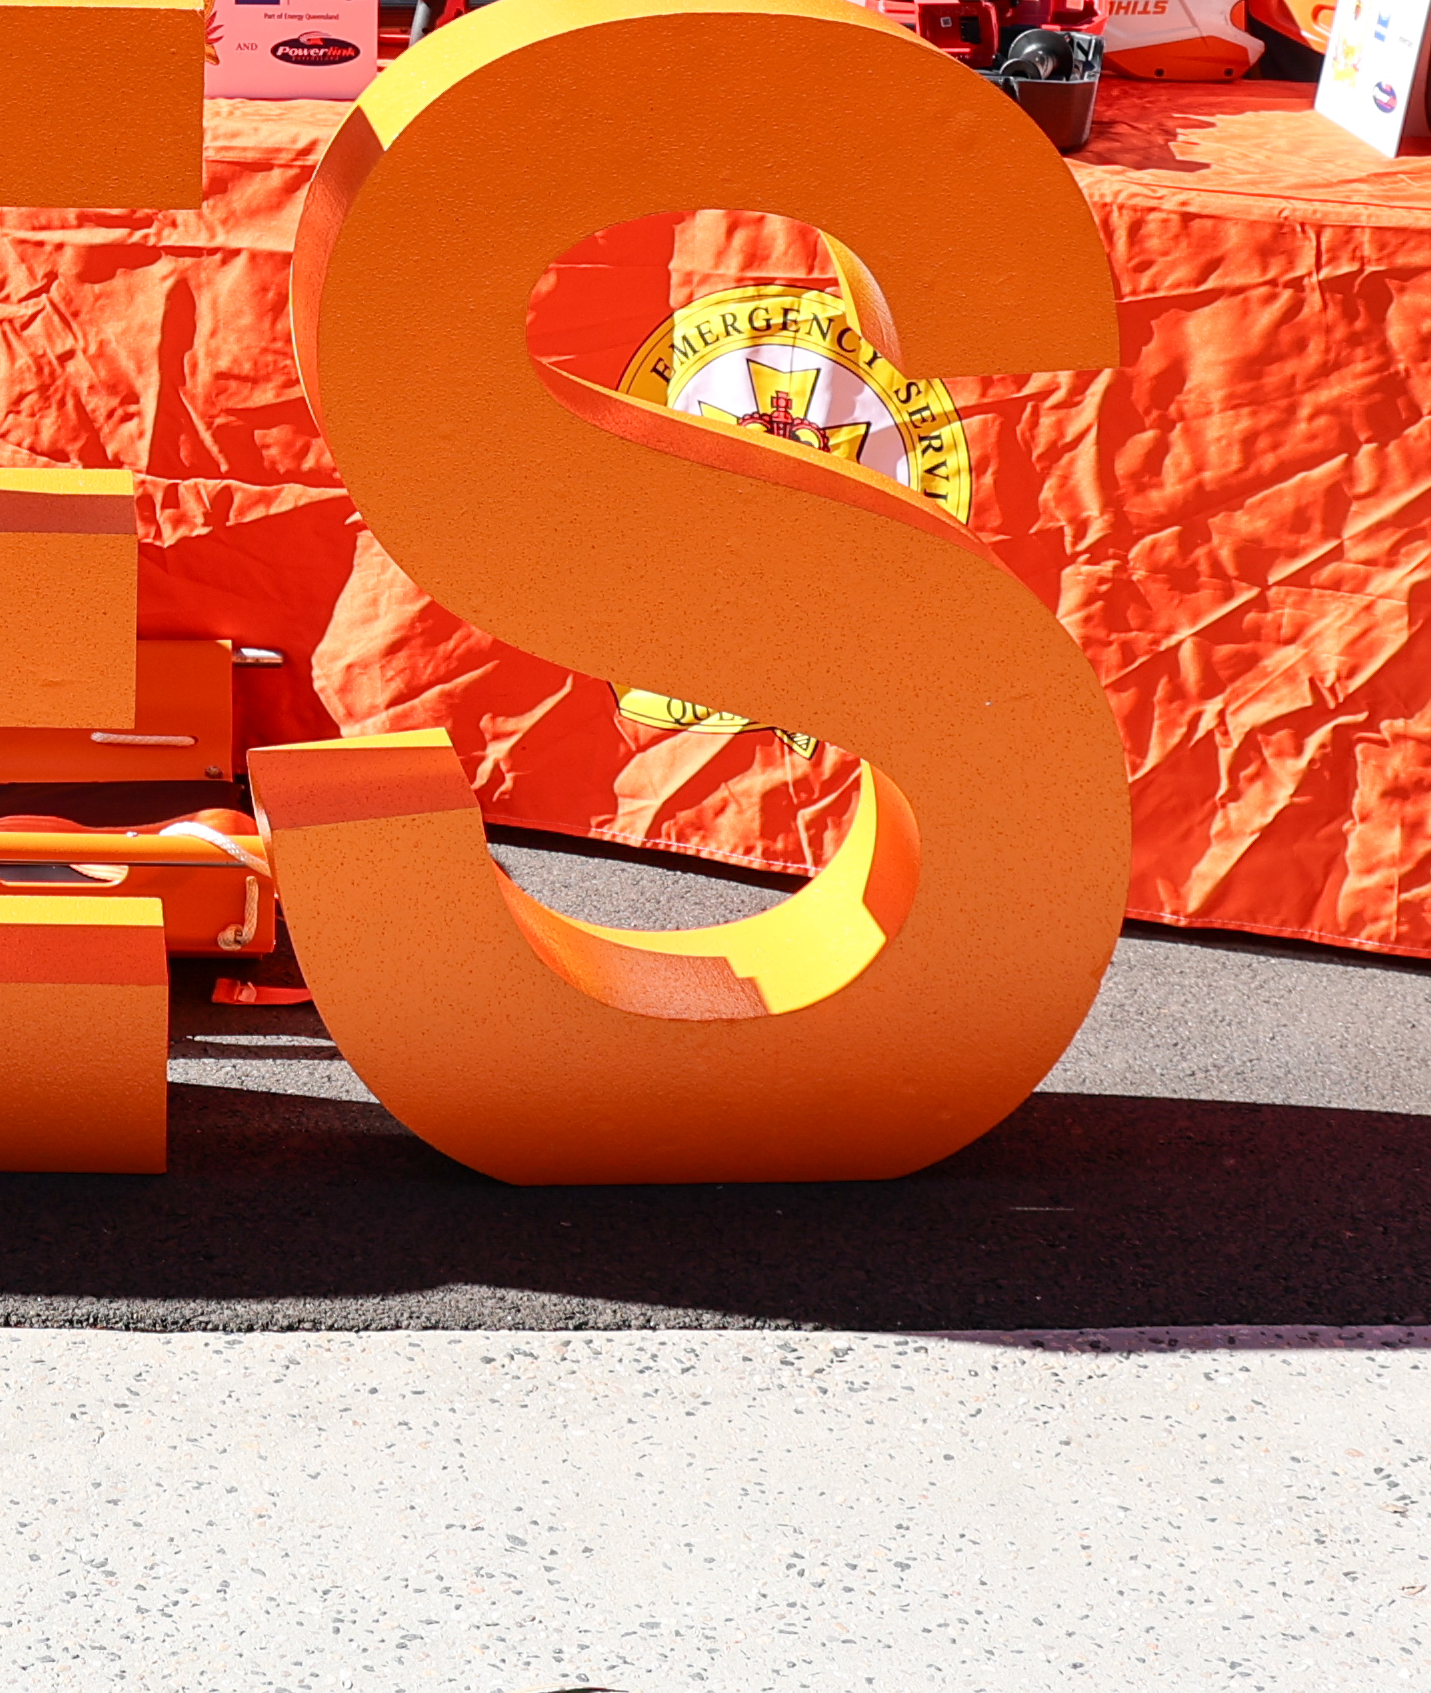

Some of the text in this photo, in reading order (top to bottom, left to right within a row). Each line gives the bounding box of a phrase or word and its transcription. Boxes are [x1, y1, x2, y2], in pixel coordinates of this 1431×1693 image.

[235, 42, 258, 51] AND
[276, 46, 355, 57] Powerlink
[650, 306, 951, 503] EMERGENCY SERVI
